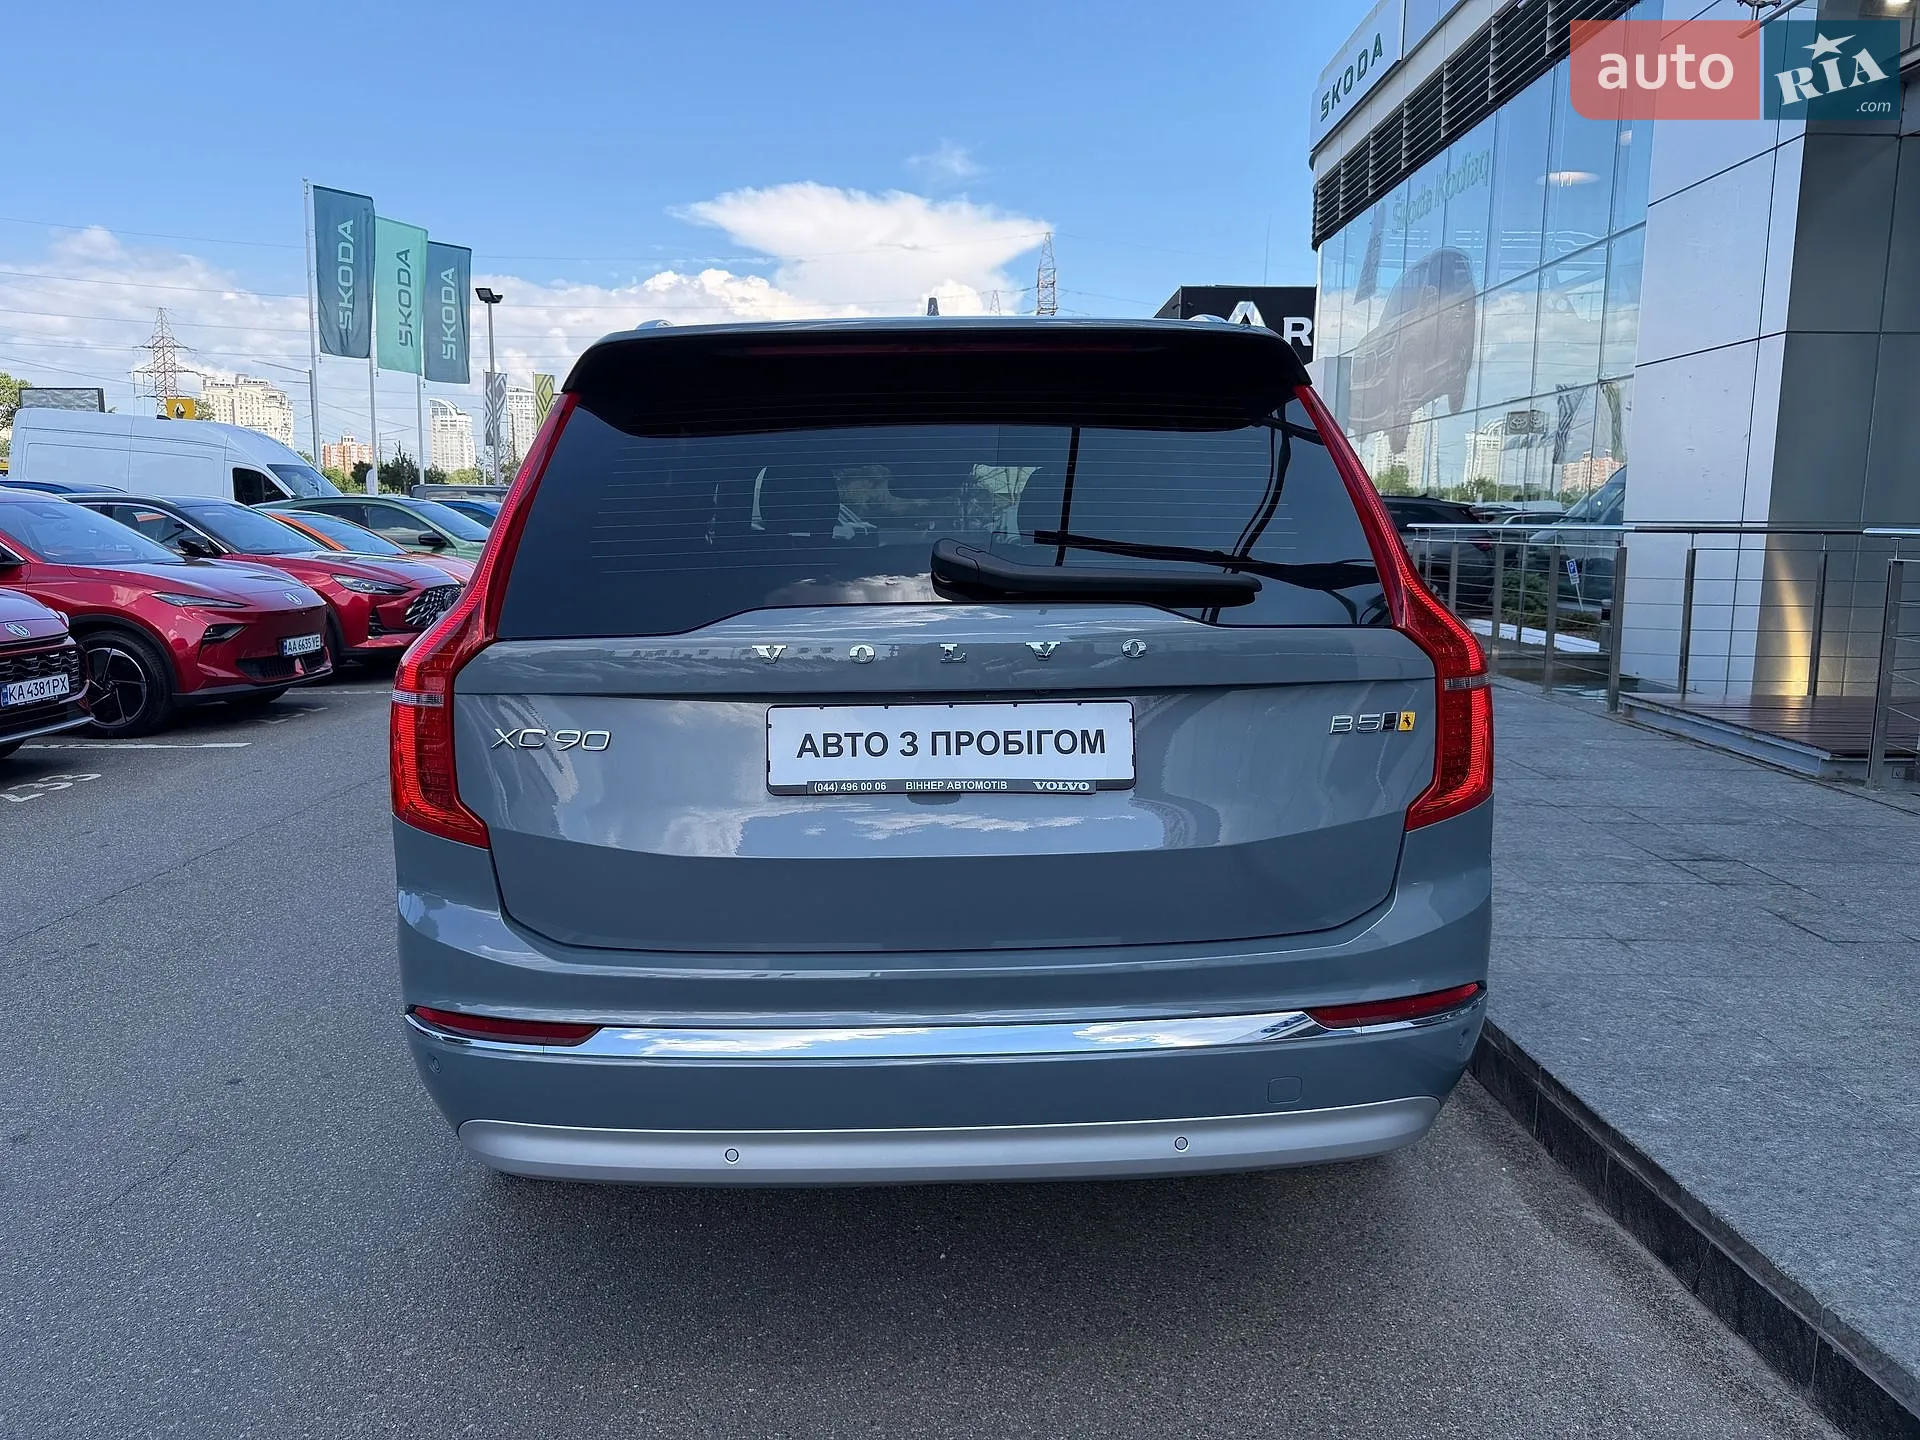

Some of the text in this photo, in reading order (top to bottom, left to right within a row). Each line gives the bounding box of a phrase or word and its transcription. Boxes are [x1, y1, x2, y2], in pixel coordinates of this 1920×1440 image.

[751, 638, 1148, 665] VOLVO
[27, 679, 51, 698] 4381
[52, 676, 68, 693] PX
[796, 731, 890, 759] АВТО
[931, 729, 1106, 756] ПРОБІГОМ
[814, 782, 887, 792] (044) 496 00 06
[905, 780, 1008, 790] ВІННЕР АВТОМОТІВ
[1033, 781, 1090, 791] VOLVO
